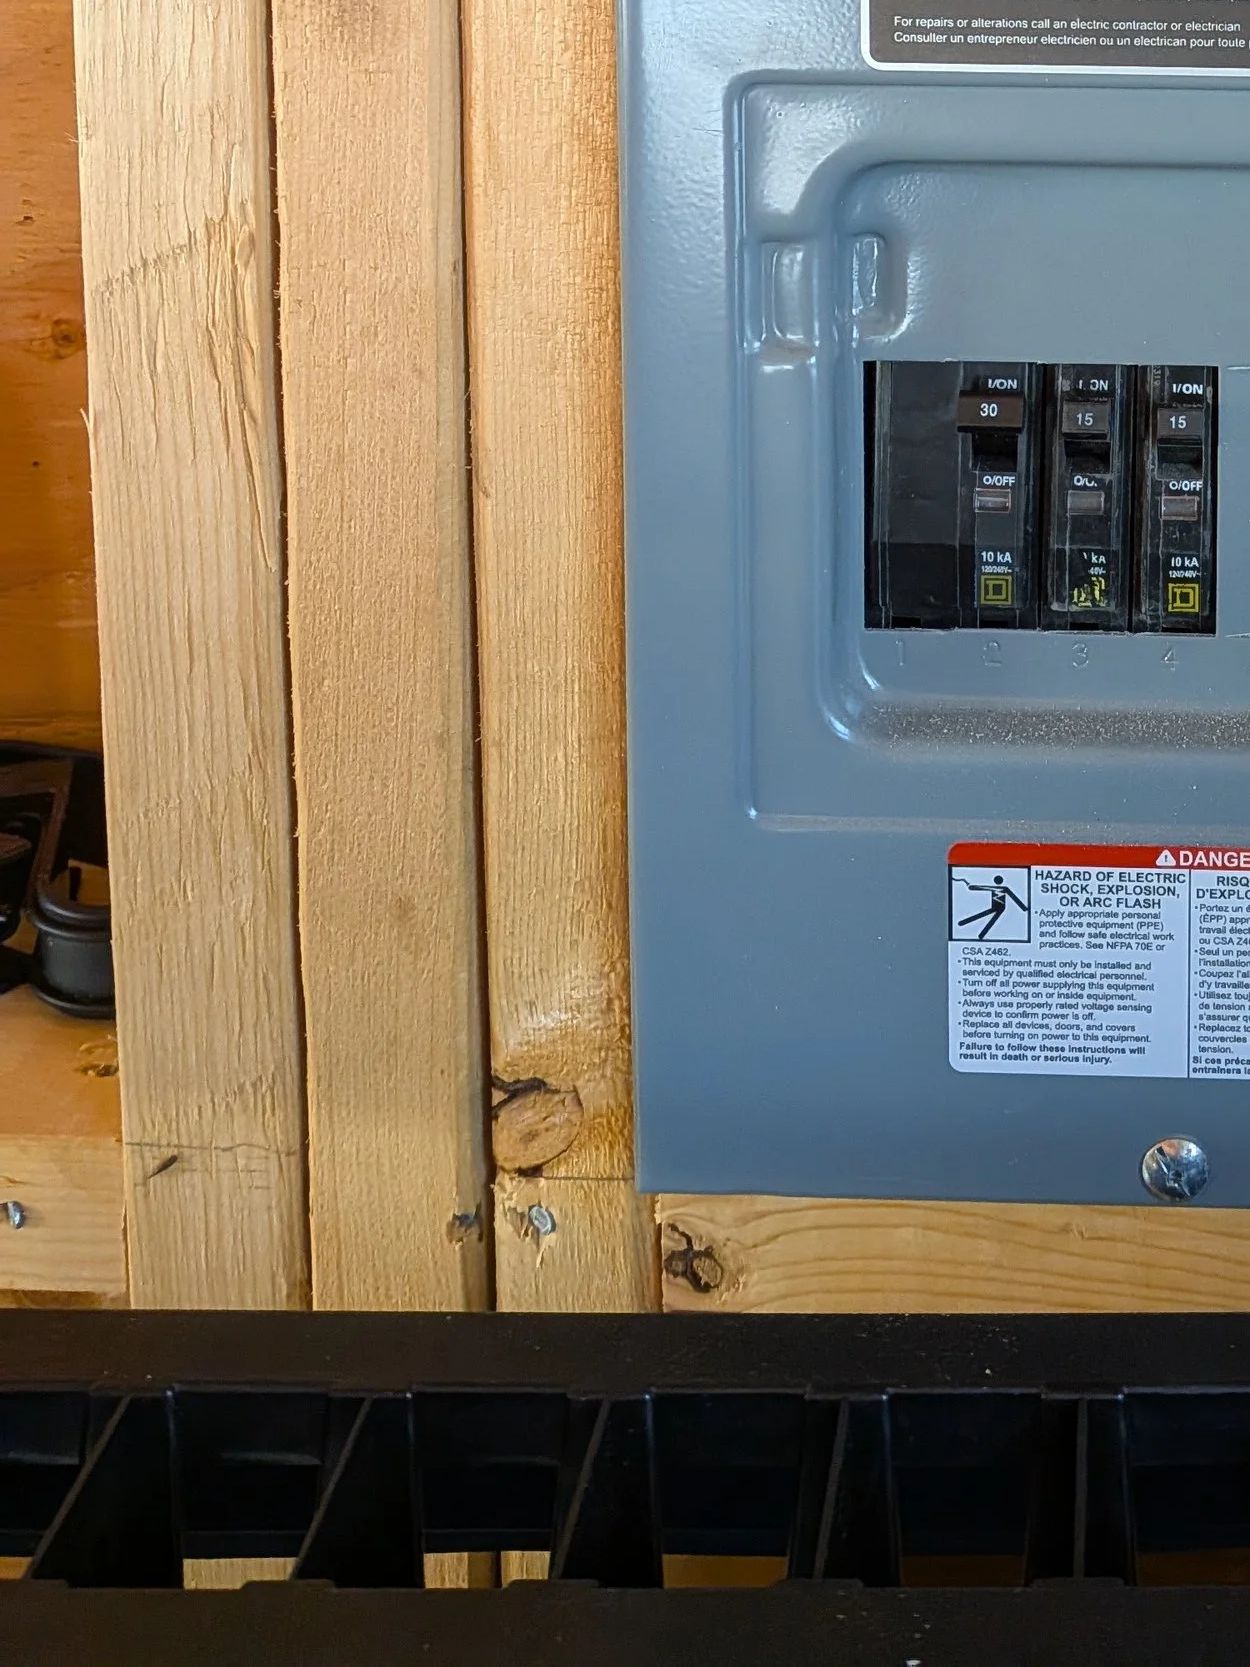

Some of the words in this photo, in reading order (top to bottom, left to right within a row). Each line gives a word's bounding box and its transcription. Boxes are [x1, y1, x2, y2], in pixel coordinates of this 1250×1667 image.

[894, 32, 947, 43] Consulter
[950, 35, 964, 43] un
[967, 34, 1038, 46] entrepreneur
[1040, 34, 1096, 45] electricien
[1099, 37, 1113, 45] ou
[1116, 37, 1130, 45] un
[1133, 35, 1186, 46] electrican
[1190, 38, 1214, 49] pour
[1218, 37, 1245, 47] toute
[1172, 383, 1203, 395] I/ON
[980, 403, 998, 417] 30
[1076, 413, 1094, 426] 15
[1169, 415, 1187, 429] 15
[981, 551, 994, 563] 10
[997, 551, 1012, 563] kA
[1171, 556, 1182, 567] 10
[1184, 556, 1199, 568] kA
[983, 641, 1001, 667] 2
[1072, 642, 1089, 669] 3
[1161, 641, 1179, 670] 4
[1035, 870, 1091, 881] HAZARD
[1096, 871, 1114, 882] OF
[1118, 872, 1185, 884] ELECTRIC
[1040, 883, 1094, 896] SHOCK,
[1097, 884, 1179, 899] EXPLOSION,
[1059, 896, 1079, 907] OR
[1082, 896, 1112, 908] ARC
[1116, 897, 1160, 909] FLASH
[1038, 908, 1065, 919] Apply
[1067, 909, 1118, 920] appropriate
[1121, 911, 1160, 922] personal
[1039, 919, 1083, 929] protective
[1086, 920, 1133, 931] equipment
[1136, 921, 1163, 933] (PPE)
[1039, 929, 1056, 938] and
[1058, 929, 1085, 939] follow
[1088, 930, 1107, 939] safe
[1109, 931, 1150, 940] electrical
[1152, 932, 1174, 941] work
[962, 946, 983, 956] CSA
[1085, 941, 1103, 949] See
[1106, 941, 1132, 950] NFPA
[1135, 942, 1152, 951] 70E
[959, 1051, 986, 1060] result
[989, 1052, 998, 1060] in
[1001, 1052, 1028, 1061] death
[1044, 1053, 1079, 1062] serious
